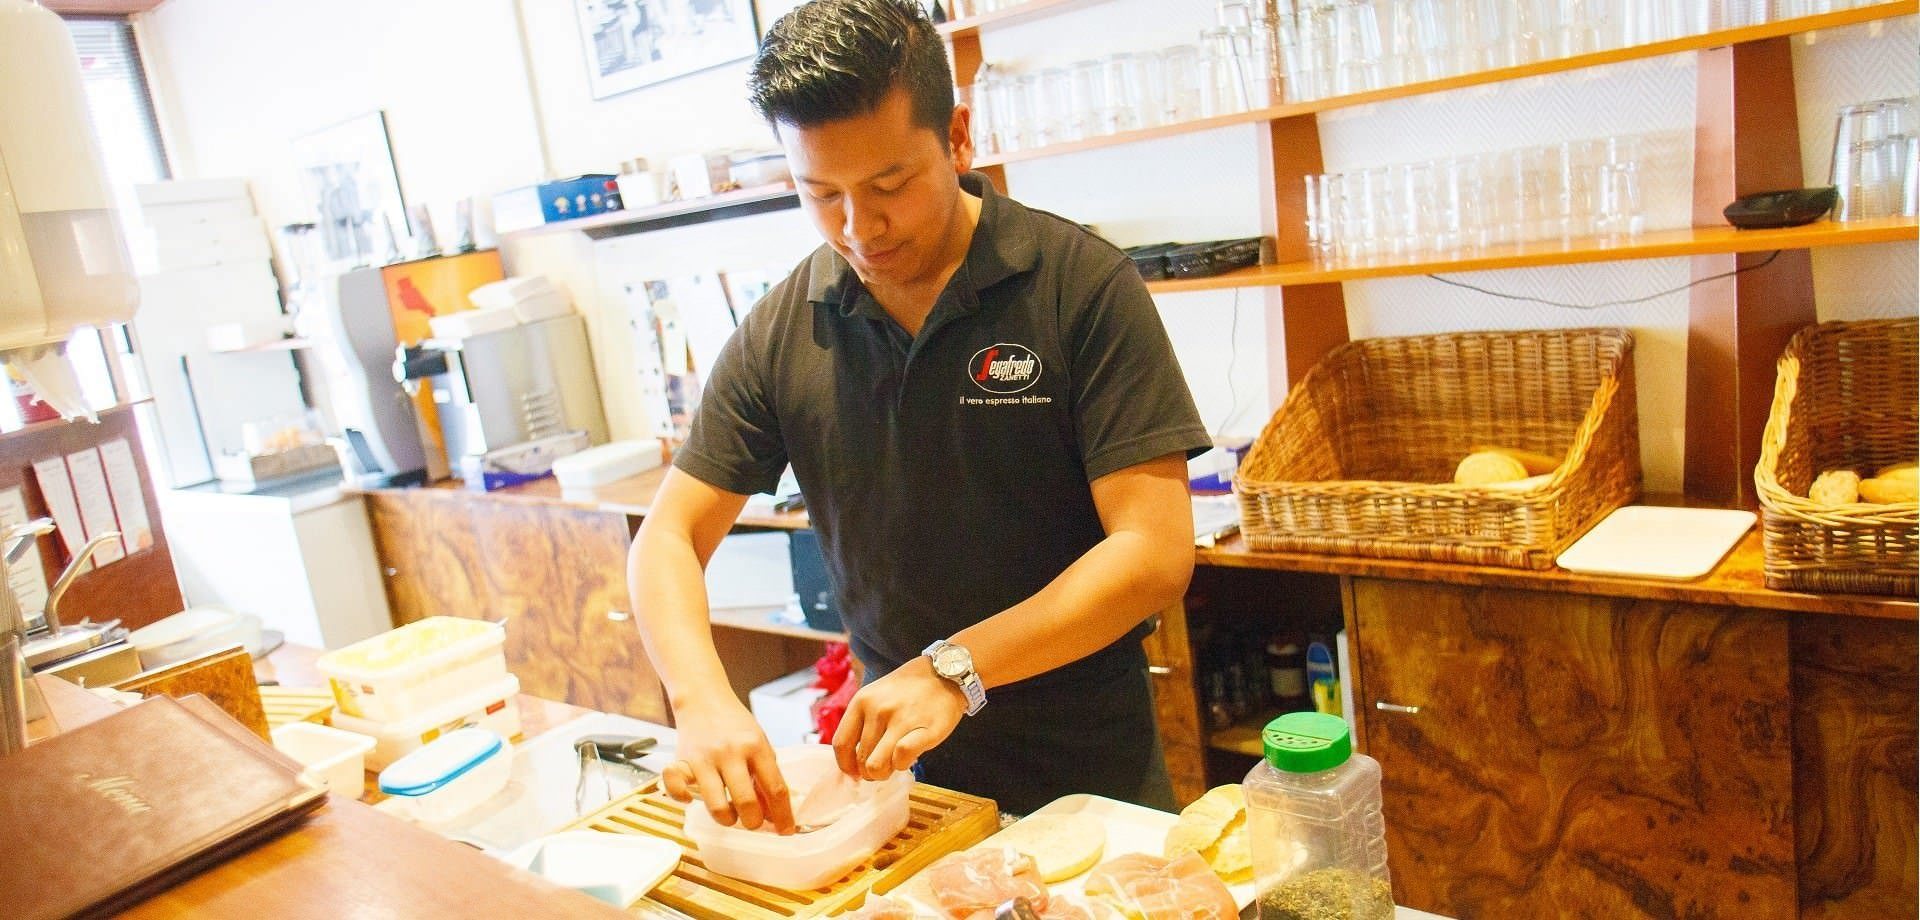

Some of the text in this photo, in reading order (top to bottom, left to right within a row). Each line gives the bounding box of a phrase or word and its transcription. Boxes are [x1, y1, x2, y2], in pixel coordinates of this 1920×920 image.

[976, 347, 1035, 382] Segafredo
[966, 397, 983, 405] vero
[985, 397, 1020, 407] espresso
[1022, 395, 1052, 405] italiano
